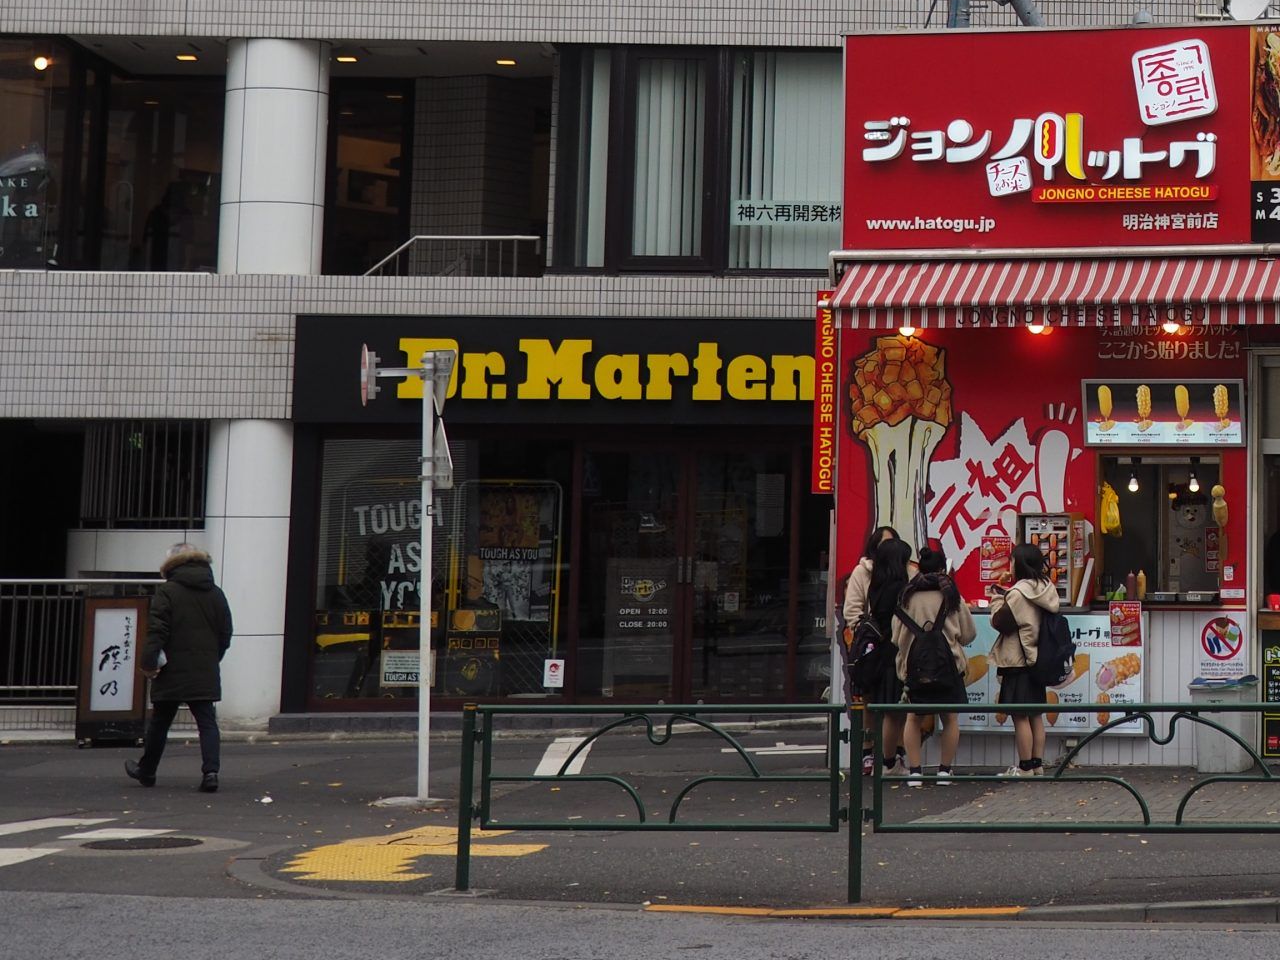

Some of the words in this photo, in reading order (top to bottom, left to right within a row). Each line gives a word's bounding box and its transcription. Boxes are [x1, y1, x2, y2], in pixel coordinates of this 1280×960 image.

[1039, 188, 1095, 201] JONGNO
[1098, 187, 1151, 200] CHEESE
[1154, 186, 1210, 198] HATOGU
[866, 216, 996, 233] www.hatogu.jp
[1122, 213, 1219, 230] 明治神宮前店
[958, 309, 1035, 325] JONGNO
[1046, 308, 1120, 324] CHEESE
[821, 294, 834, 358] JNGNO
[820, 362, 834, 423] CHEESE
[818, 427, 832, 491] HATOGU
[388, 541, 422, 575] AS
[480, 548, 508, 559] TOUGH
[509, 548, 521, 559] AS
[522, 548, 539, 560] YOU
